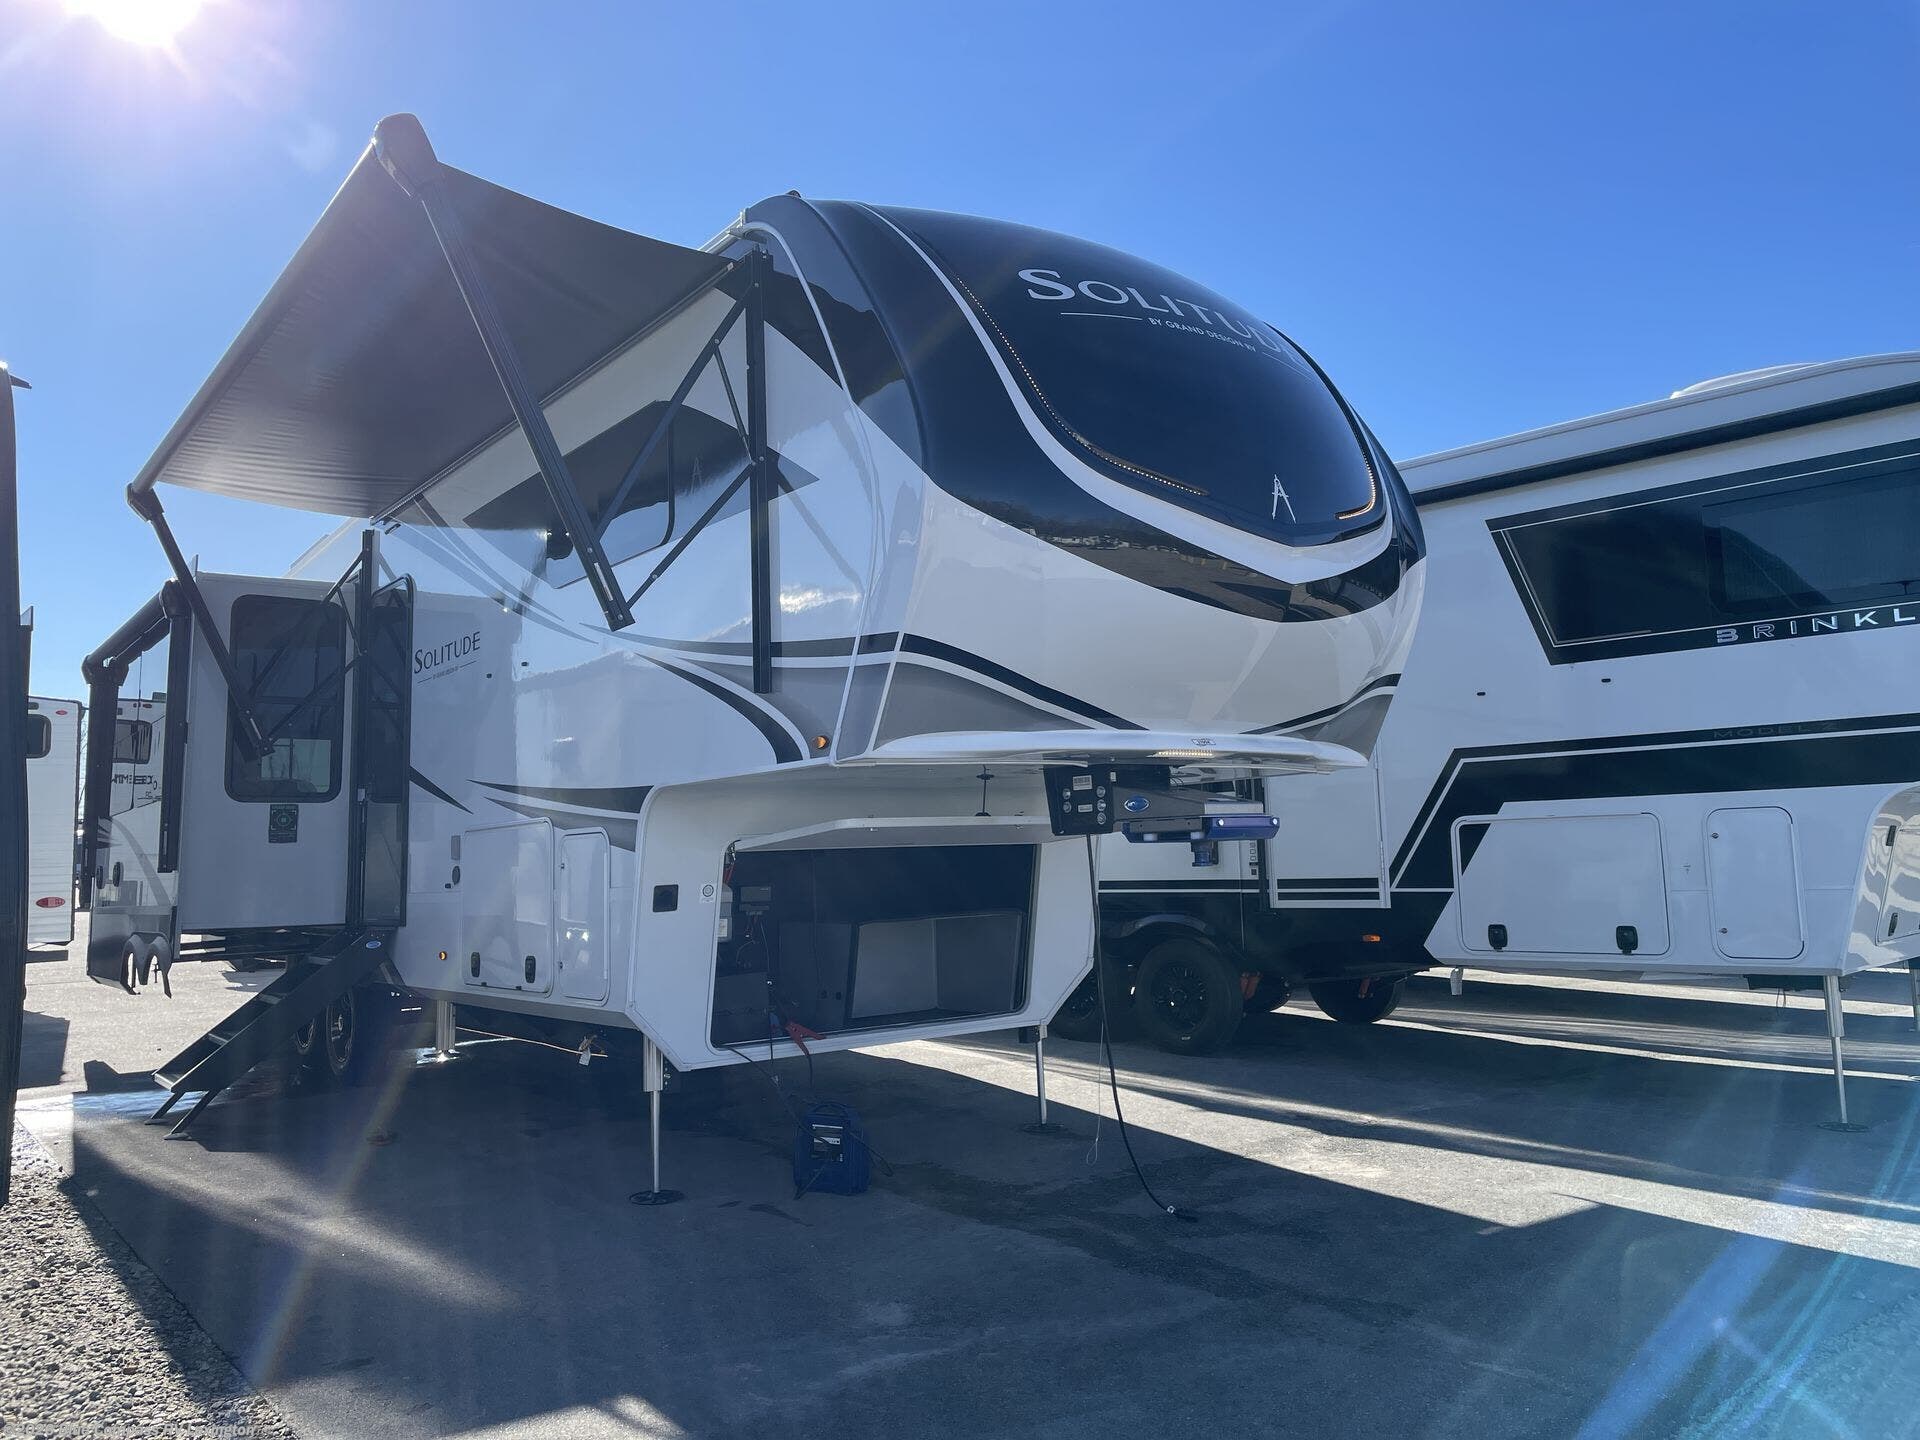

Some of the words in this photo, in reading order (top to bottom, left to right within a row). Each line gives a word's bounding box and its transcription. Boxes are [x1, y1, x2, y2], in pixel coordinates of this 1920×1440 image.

[1149, 317, 1163, 326] BY
[1165, 320, 1205, 335] GRAND
[1206, 330, 1244, 346] DESIGN
[414, 631, 481, 674] SOLITUDE
[1713, 724, 1811, 739] MODEL
